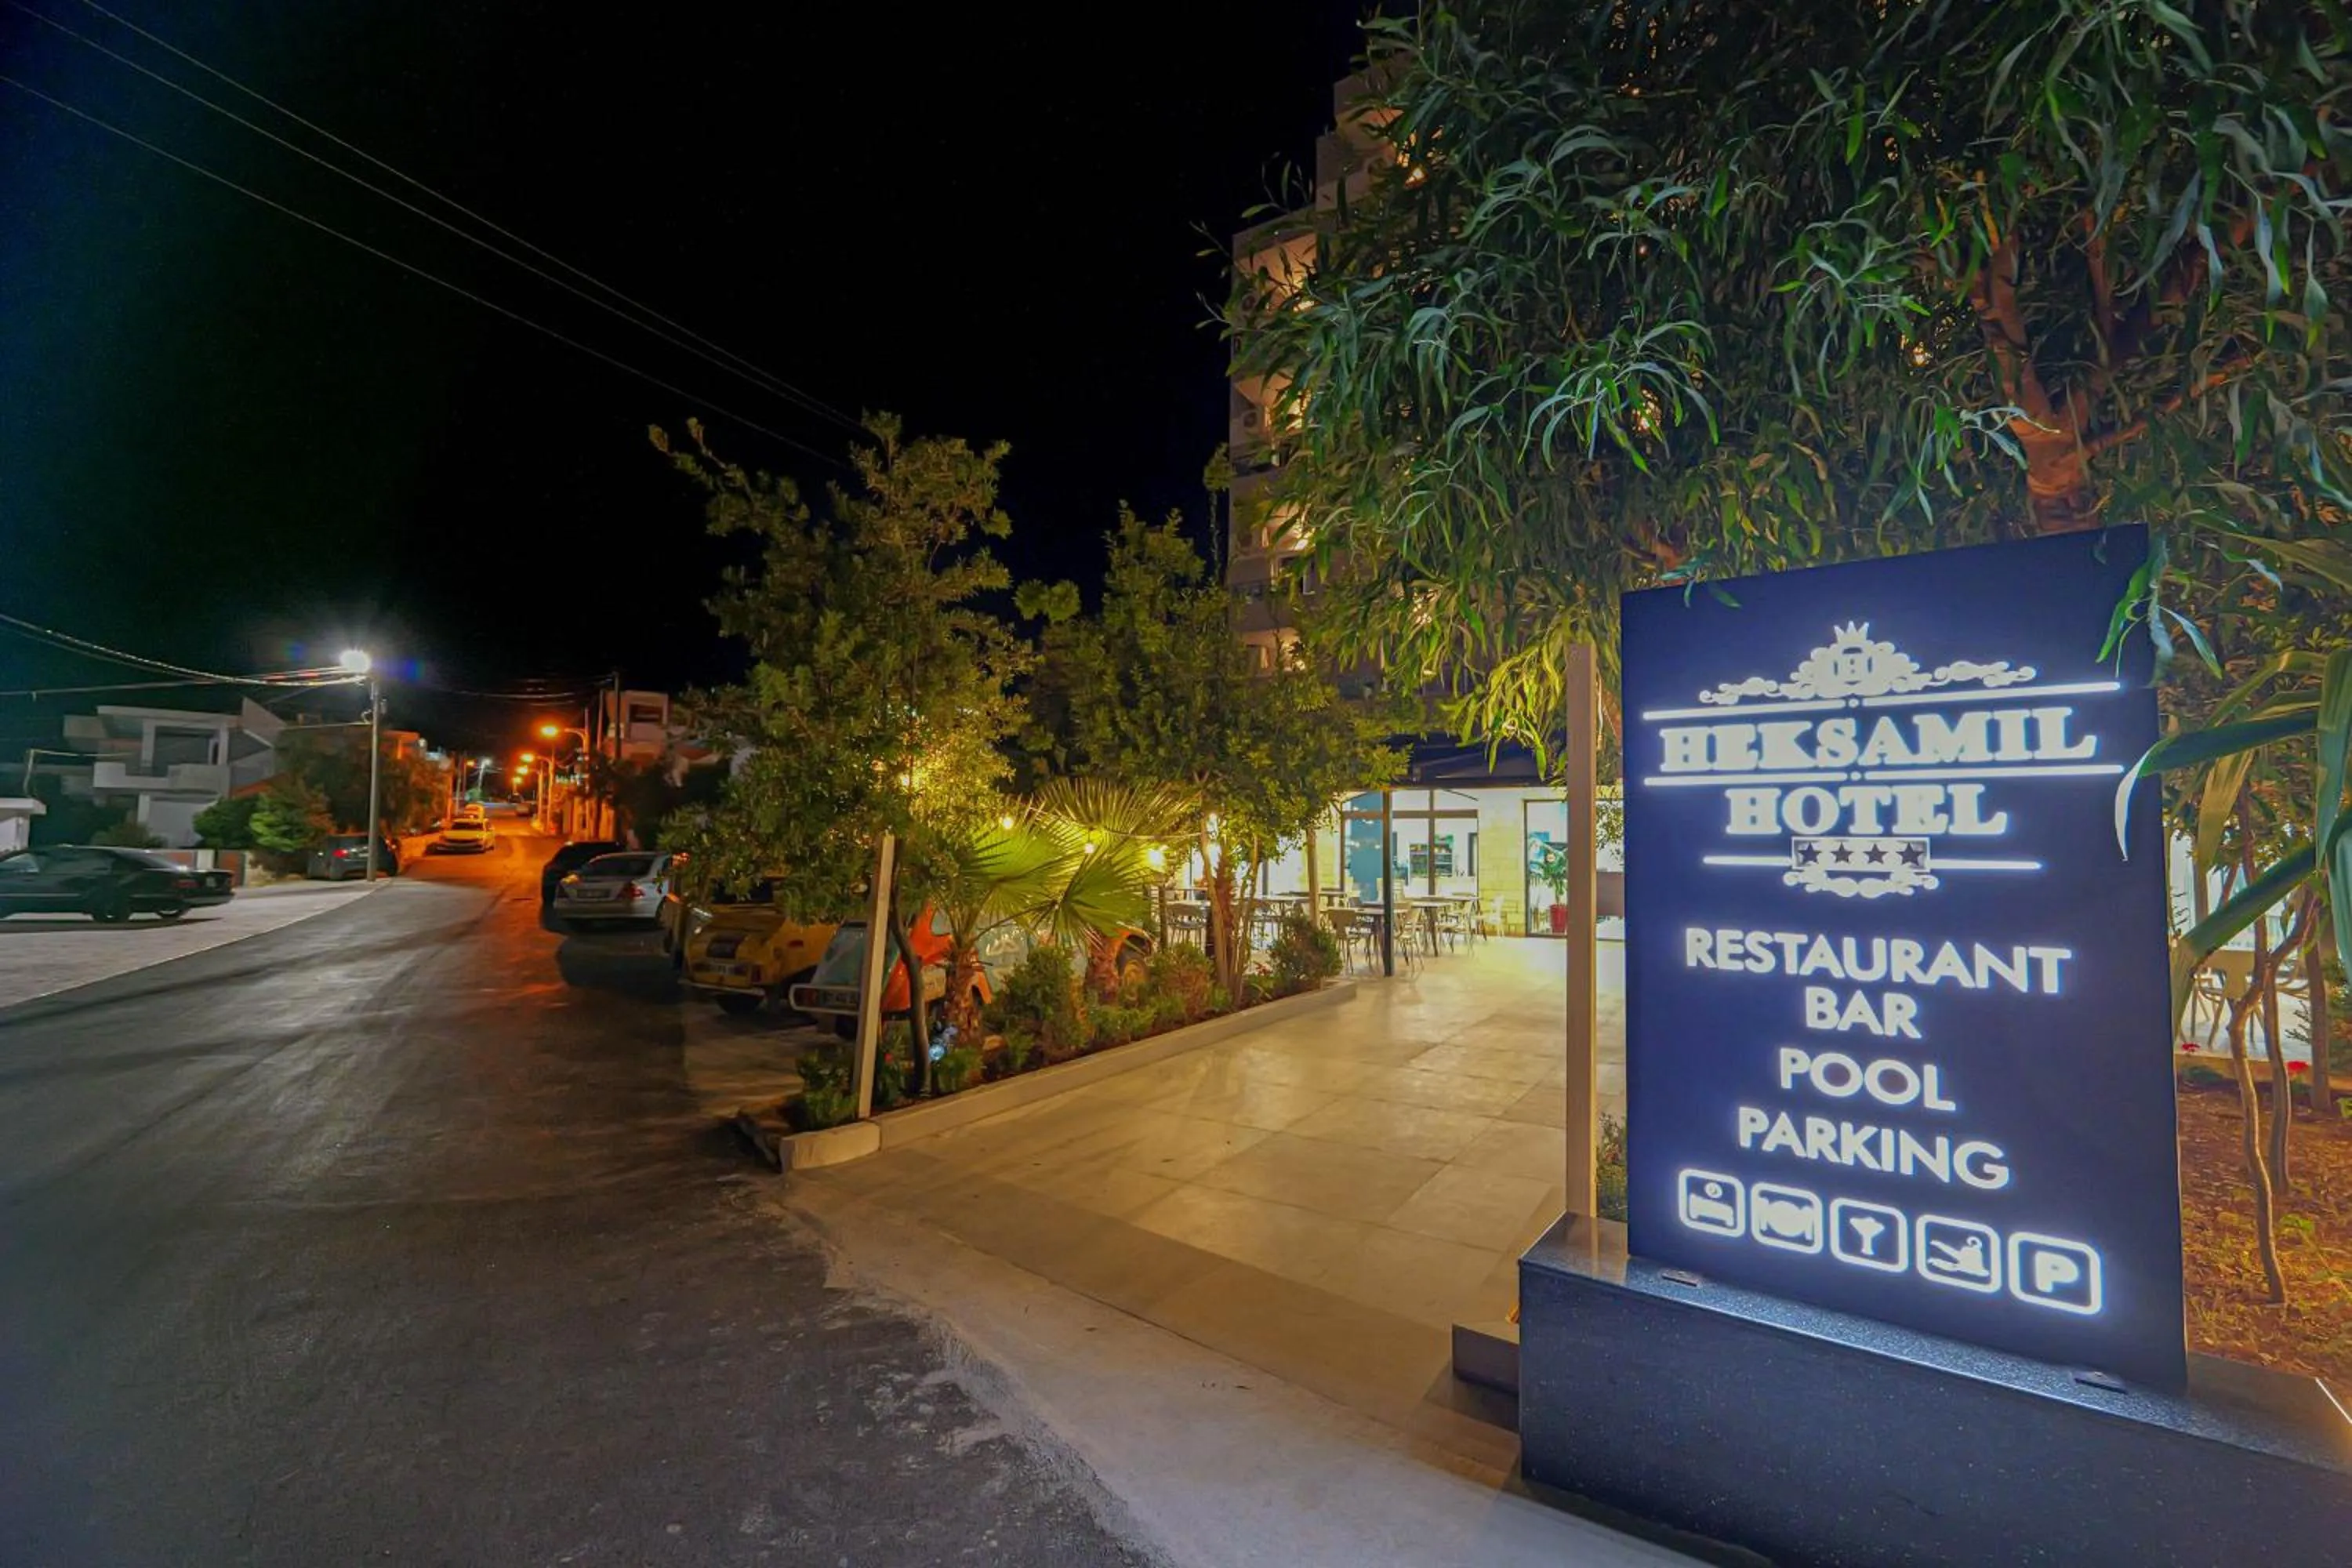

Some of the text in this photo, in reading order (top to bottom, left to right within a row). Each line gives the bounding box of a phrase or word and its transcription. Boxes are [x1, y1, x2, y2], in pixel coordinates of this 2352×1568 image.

[1659, 707, 2098, 772] HEKSAMIL
[1726, 784, 2008, 835] HOTEL
[1685, 927, 2072, 993] RESTAURANT
[1805, 986, 1922, 1039] BAR
[1780, 1047, 1956, 1112] POOL
[1737, 1106, 2010, 1190] PARKING
